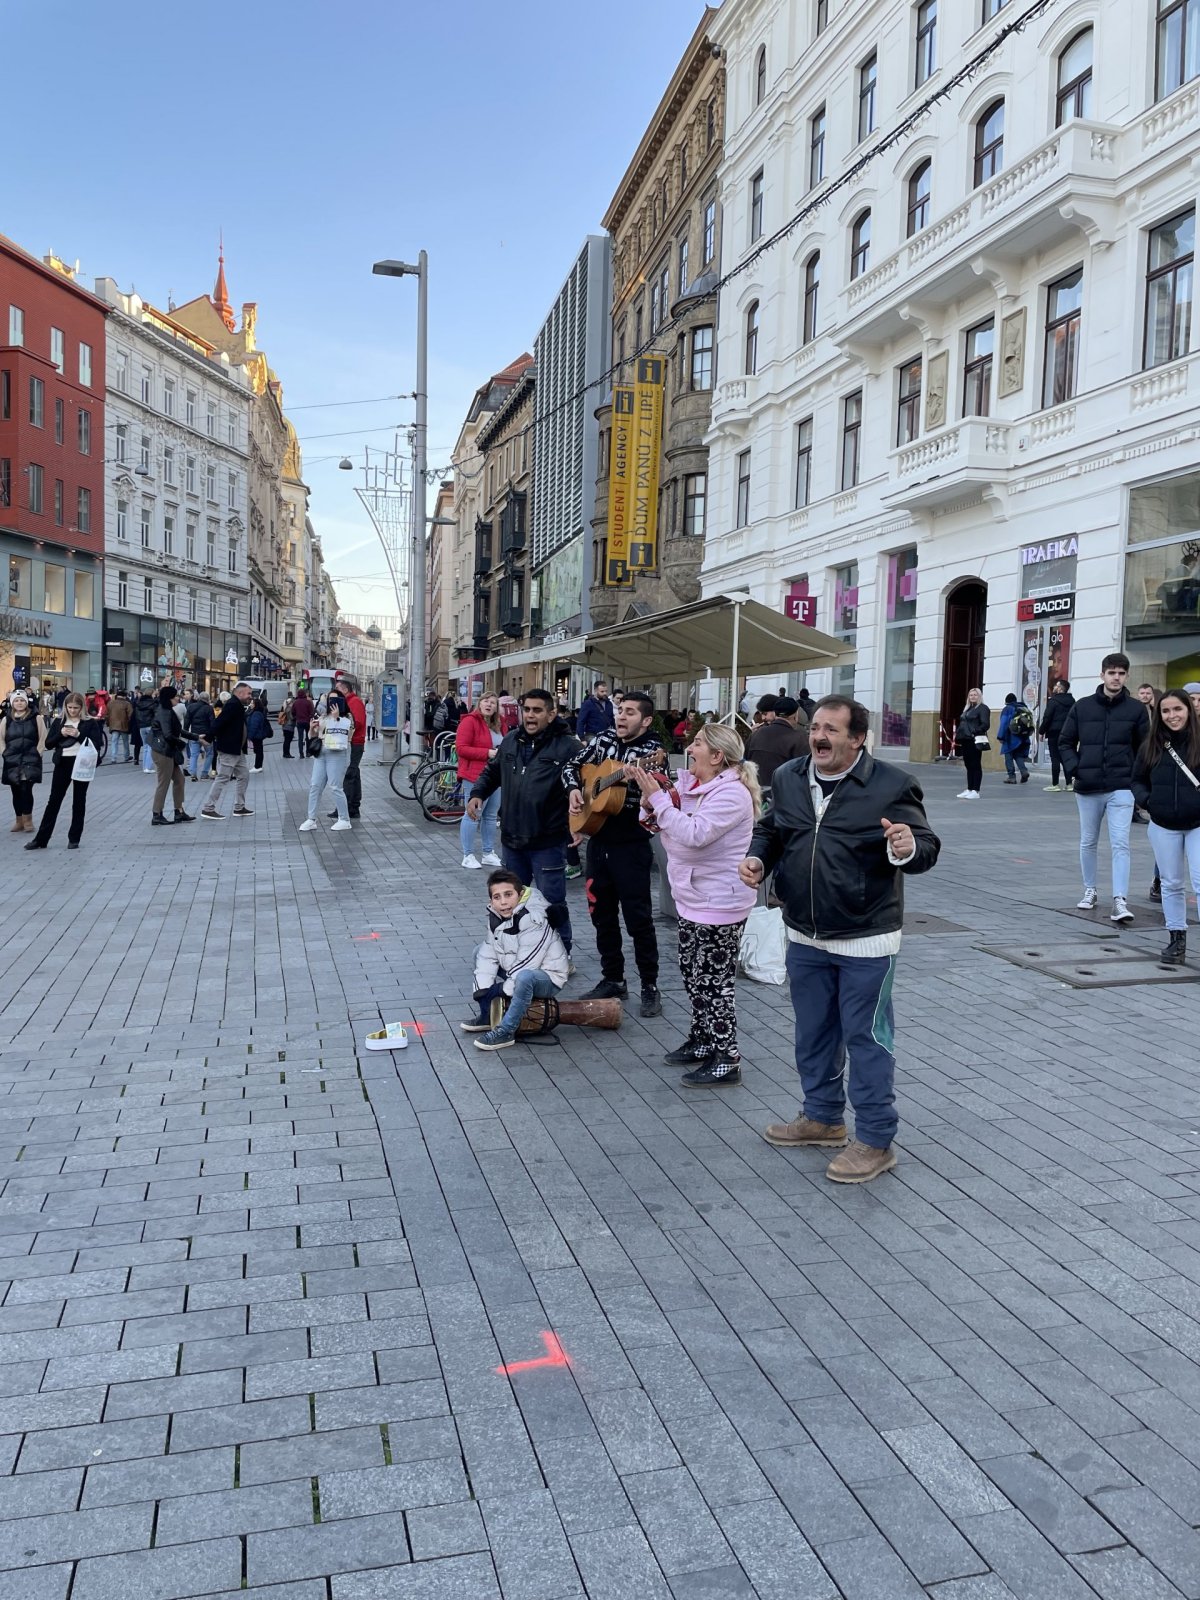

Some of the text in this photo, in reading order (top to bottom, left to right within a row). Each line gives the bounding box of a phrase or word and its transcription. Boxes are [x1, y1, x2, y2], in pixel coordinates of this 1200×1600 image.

[640, 429, 651, 437] Z
[636, 445, 652, 488] PÁNŮ
[613, 427, 627, 547] STUDENT AGENCY
[633, 498, 648, 536] DŮM
[1022, 538, 1077, 565] TRAFIKA
[1020, 598, 1071, 615] TOBACCO
[0, 613, 53, 638] UMANIC
[1051, 630, 1063, 645] glo
